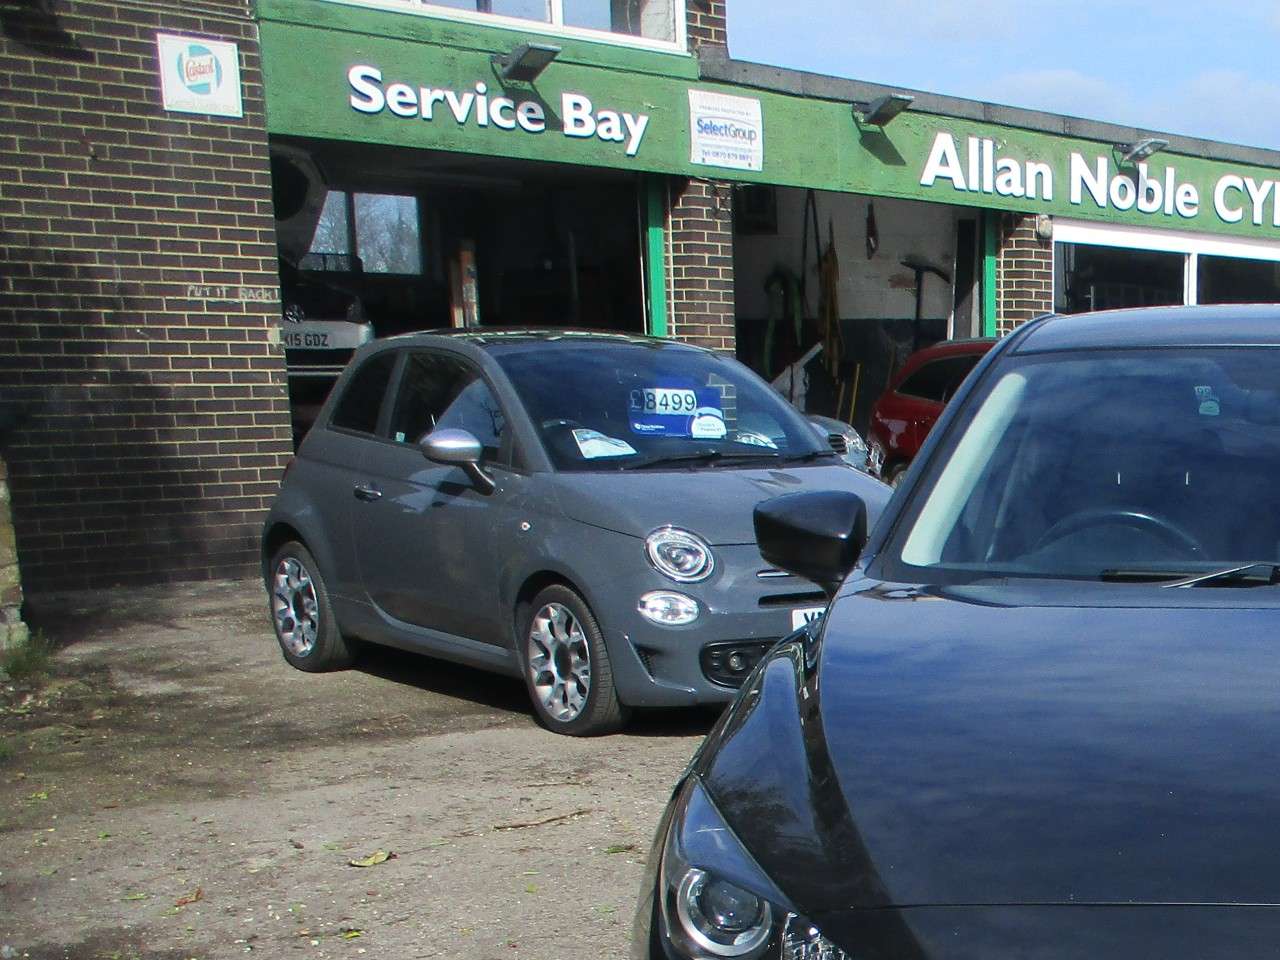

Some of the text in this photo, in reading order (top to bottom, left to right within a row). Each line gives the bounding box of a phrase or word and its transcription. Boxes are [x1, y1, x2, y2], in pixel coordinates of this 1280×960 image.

[347, 64, 649, 157] Service Bay
[697, 118, 757, 145] SelectGroup
[919, 132, 1053, 202] Allan
[1069, 151, 1200, 218] Noble
[187, 285, 279, 301] PUT IT BACK!
[304, 334, 329, 347] GDZ
